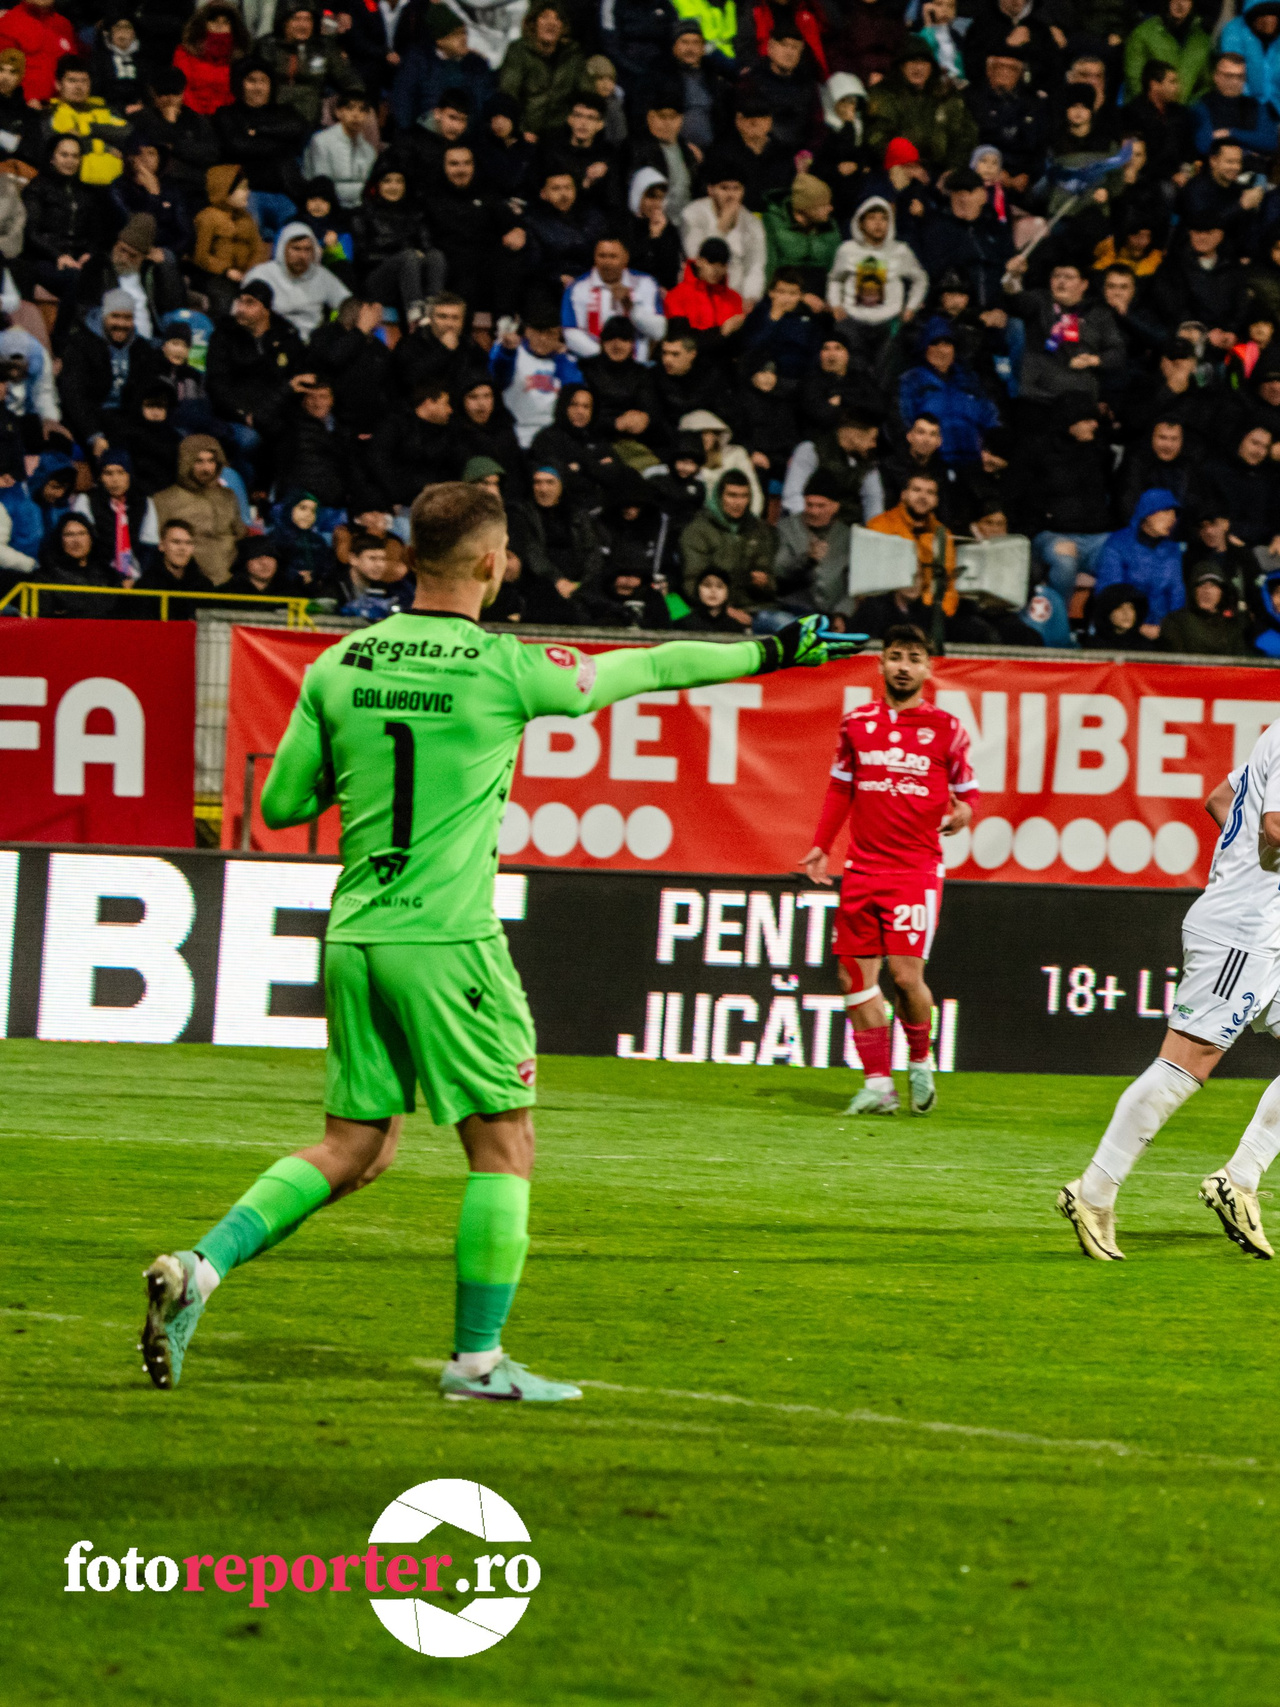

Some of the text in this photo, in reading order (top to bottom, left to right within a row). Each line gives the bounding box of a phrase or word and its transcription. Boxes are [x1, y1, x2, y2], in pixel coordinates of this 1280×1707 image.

[361, 637, 480, 662] Regata.ro
[352, 687, 454, 713] GOLUBOVIC
[522, 683, 763, 785] BET
[384, 721, 415, 849] 1
[655, 887, 840, 967] PENT
[893, 903, 928, 932] 20
[1040, 965, 1126, 1016] 18+
[1136, 966, 1178, 1019] Li
